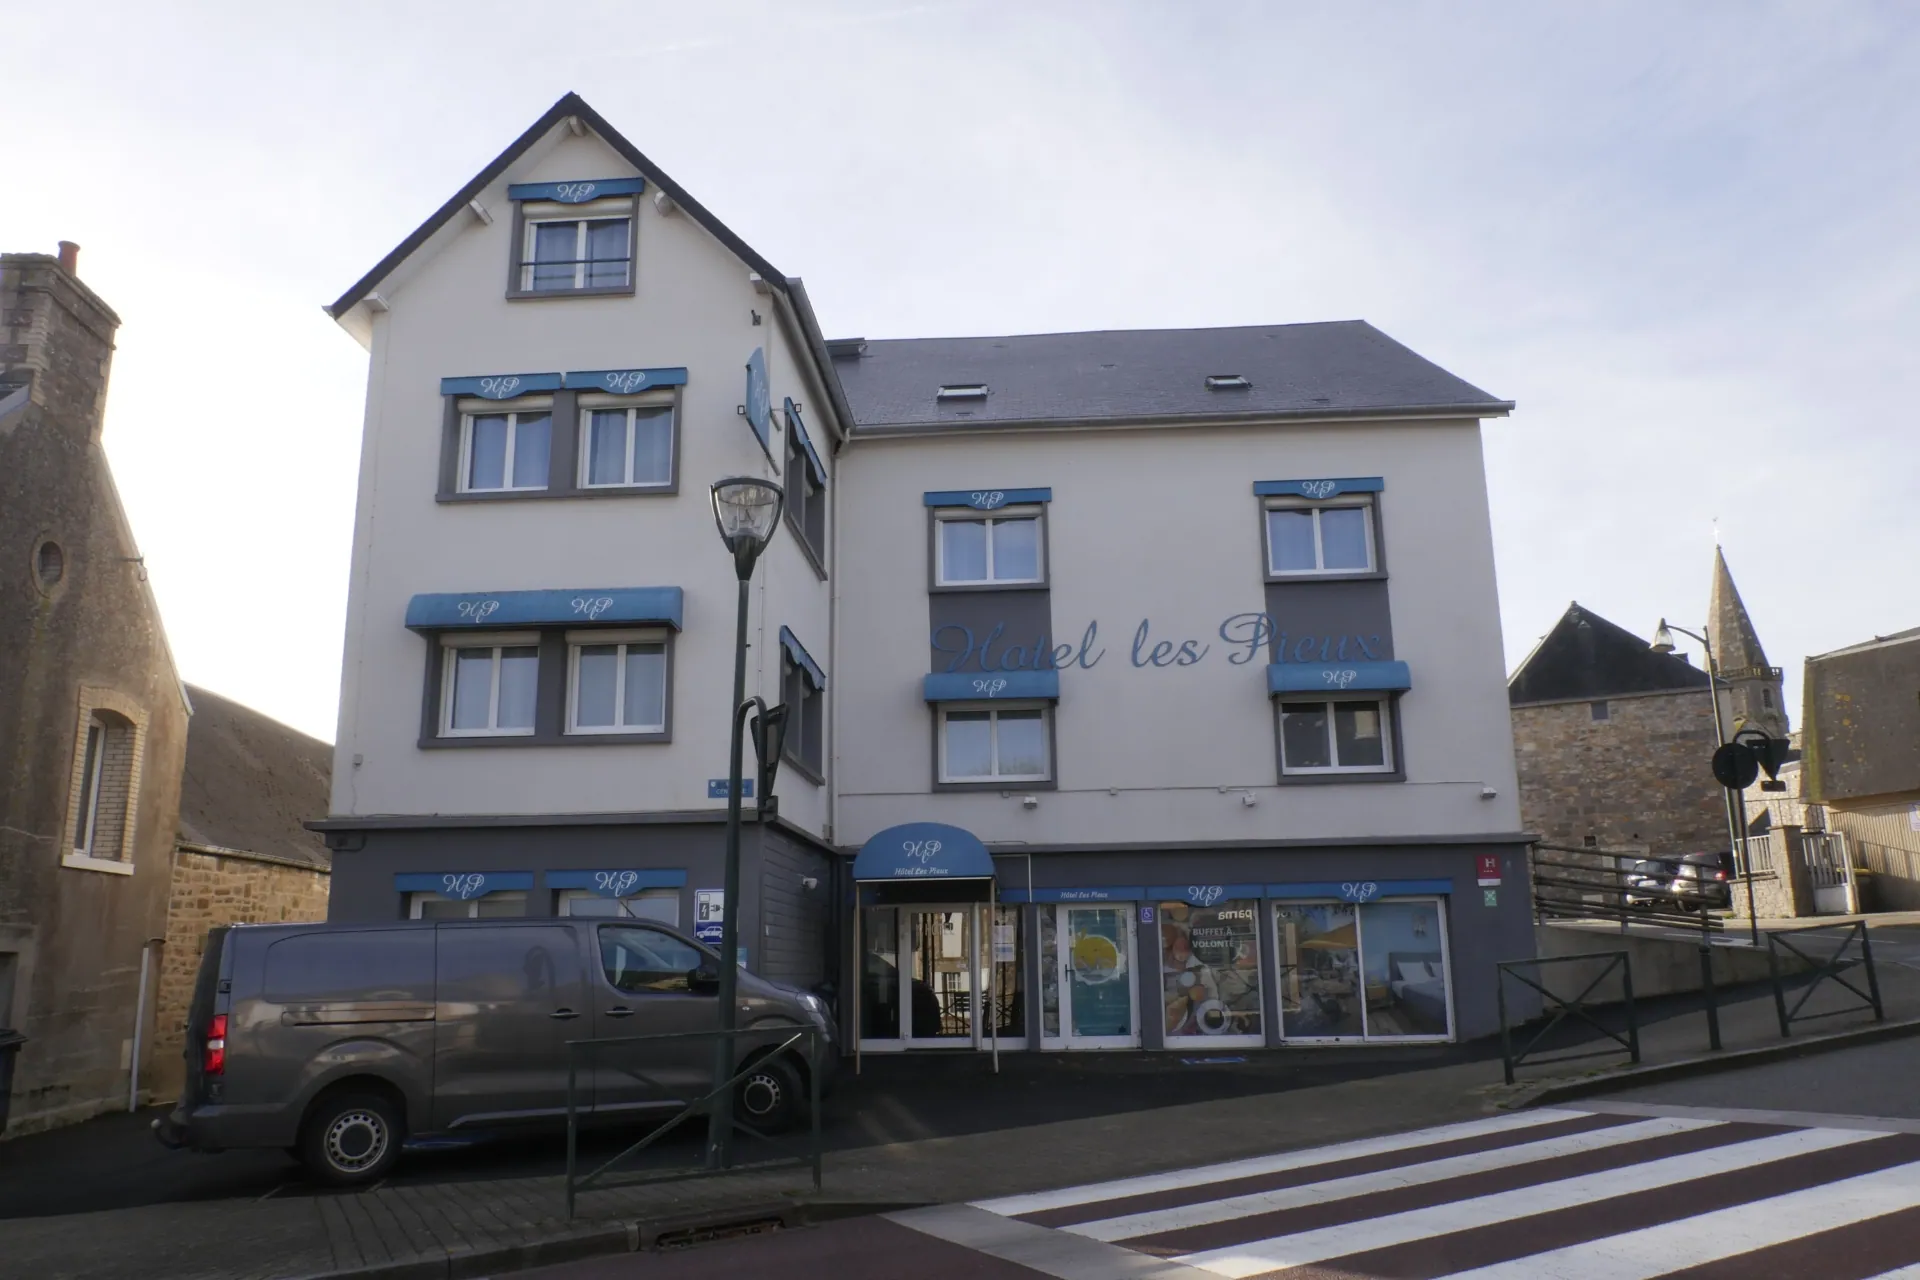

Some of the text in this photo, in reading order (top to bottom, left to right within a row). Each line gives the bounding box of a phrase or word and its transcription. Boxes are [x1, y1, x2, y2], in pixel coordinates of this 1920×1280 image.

[1132, 618, 1210, 668] les
[1219, 611, 1384, 664] Pieux
[1484, 857, 1495, 868] H
[1192, 927, 1224, 936] BUFFET
